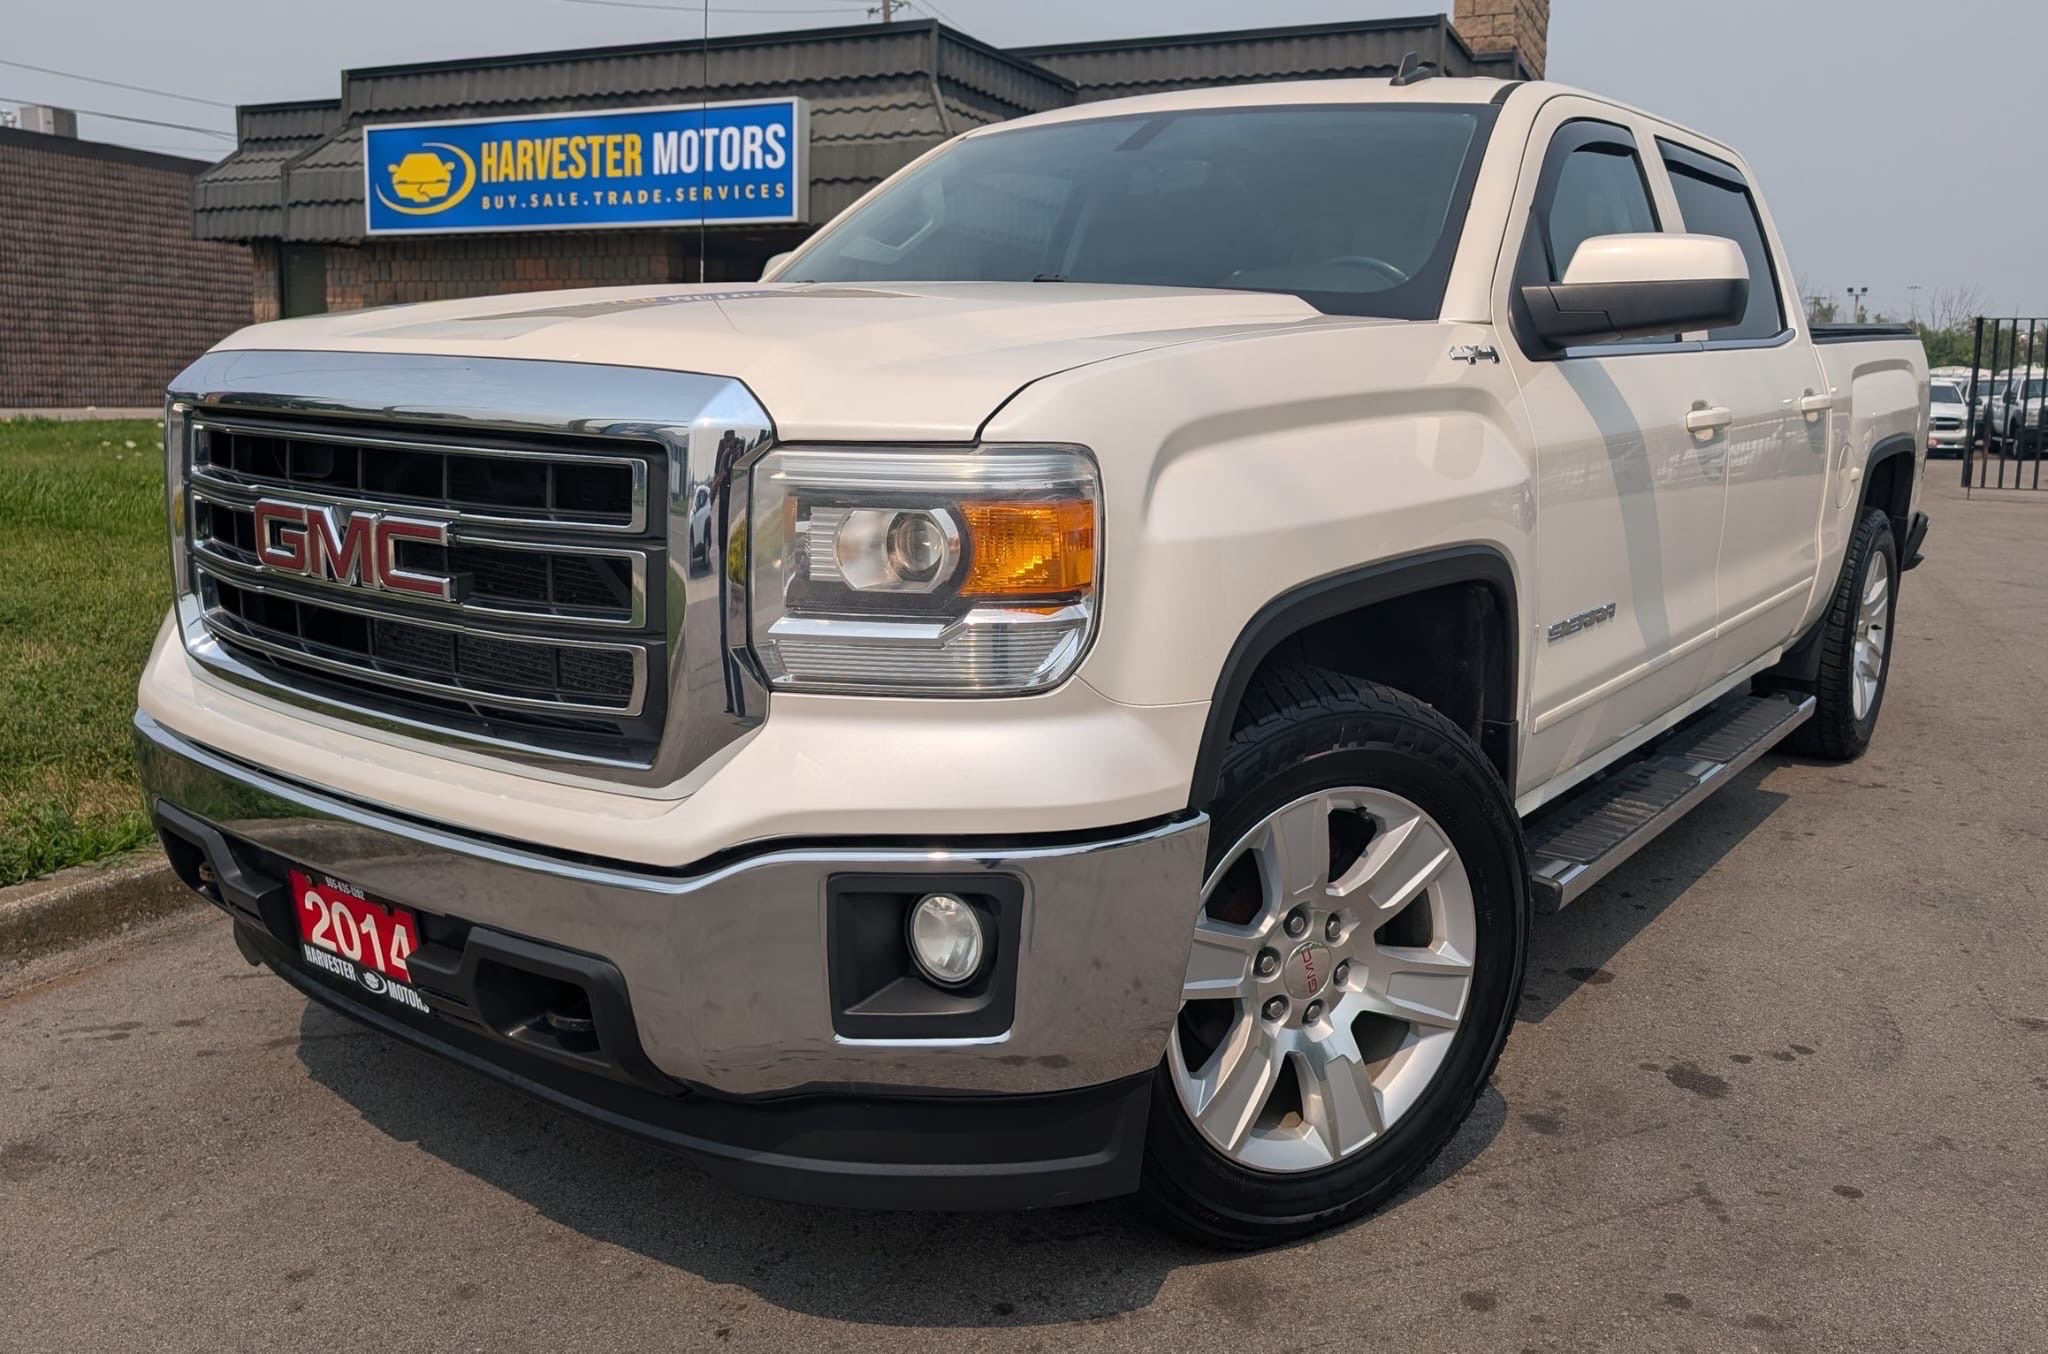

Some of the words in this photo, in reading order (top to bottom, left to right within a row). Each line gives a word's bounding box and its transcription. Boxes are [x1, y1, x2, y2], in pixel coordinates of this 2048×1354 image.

[482, 134, 642, 182] HARVESTER
[653, 123, 786, 175] MOTORS
[255, 497, 456, 602] GMC
[304, 890, 412, 984] 2014
[304, 943, 357, 982] HARVESTER
[1300, 947, 1319, 995] GMC
